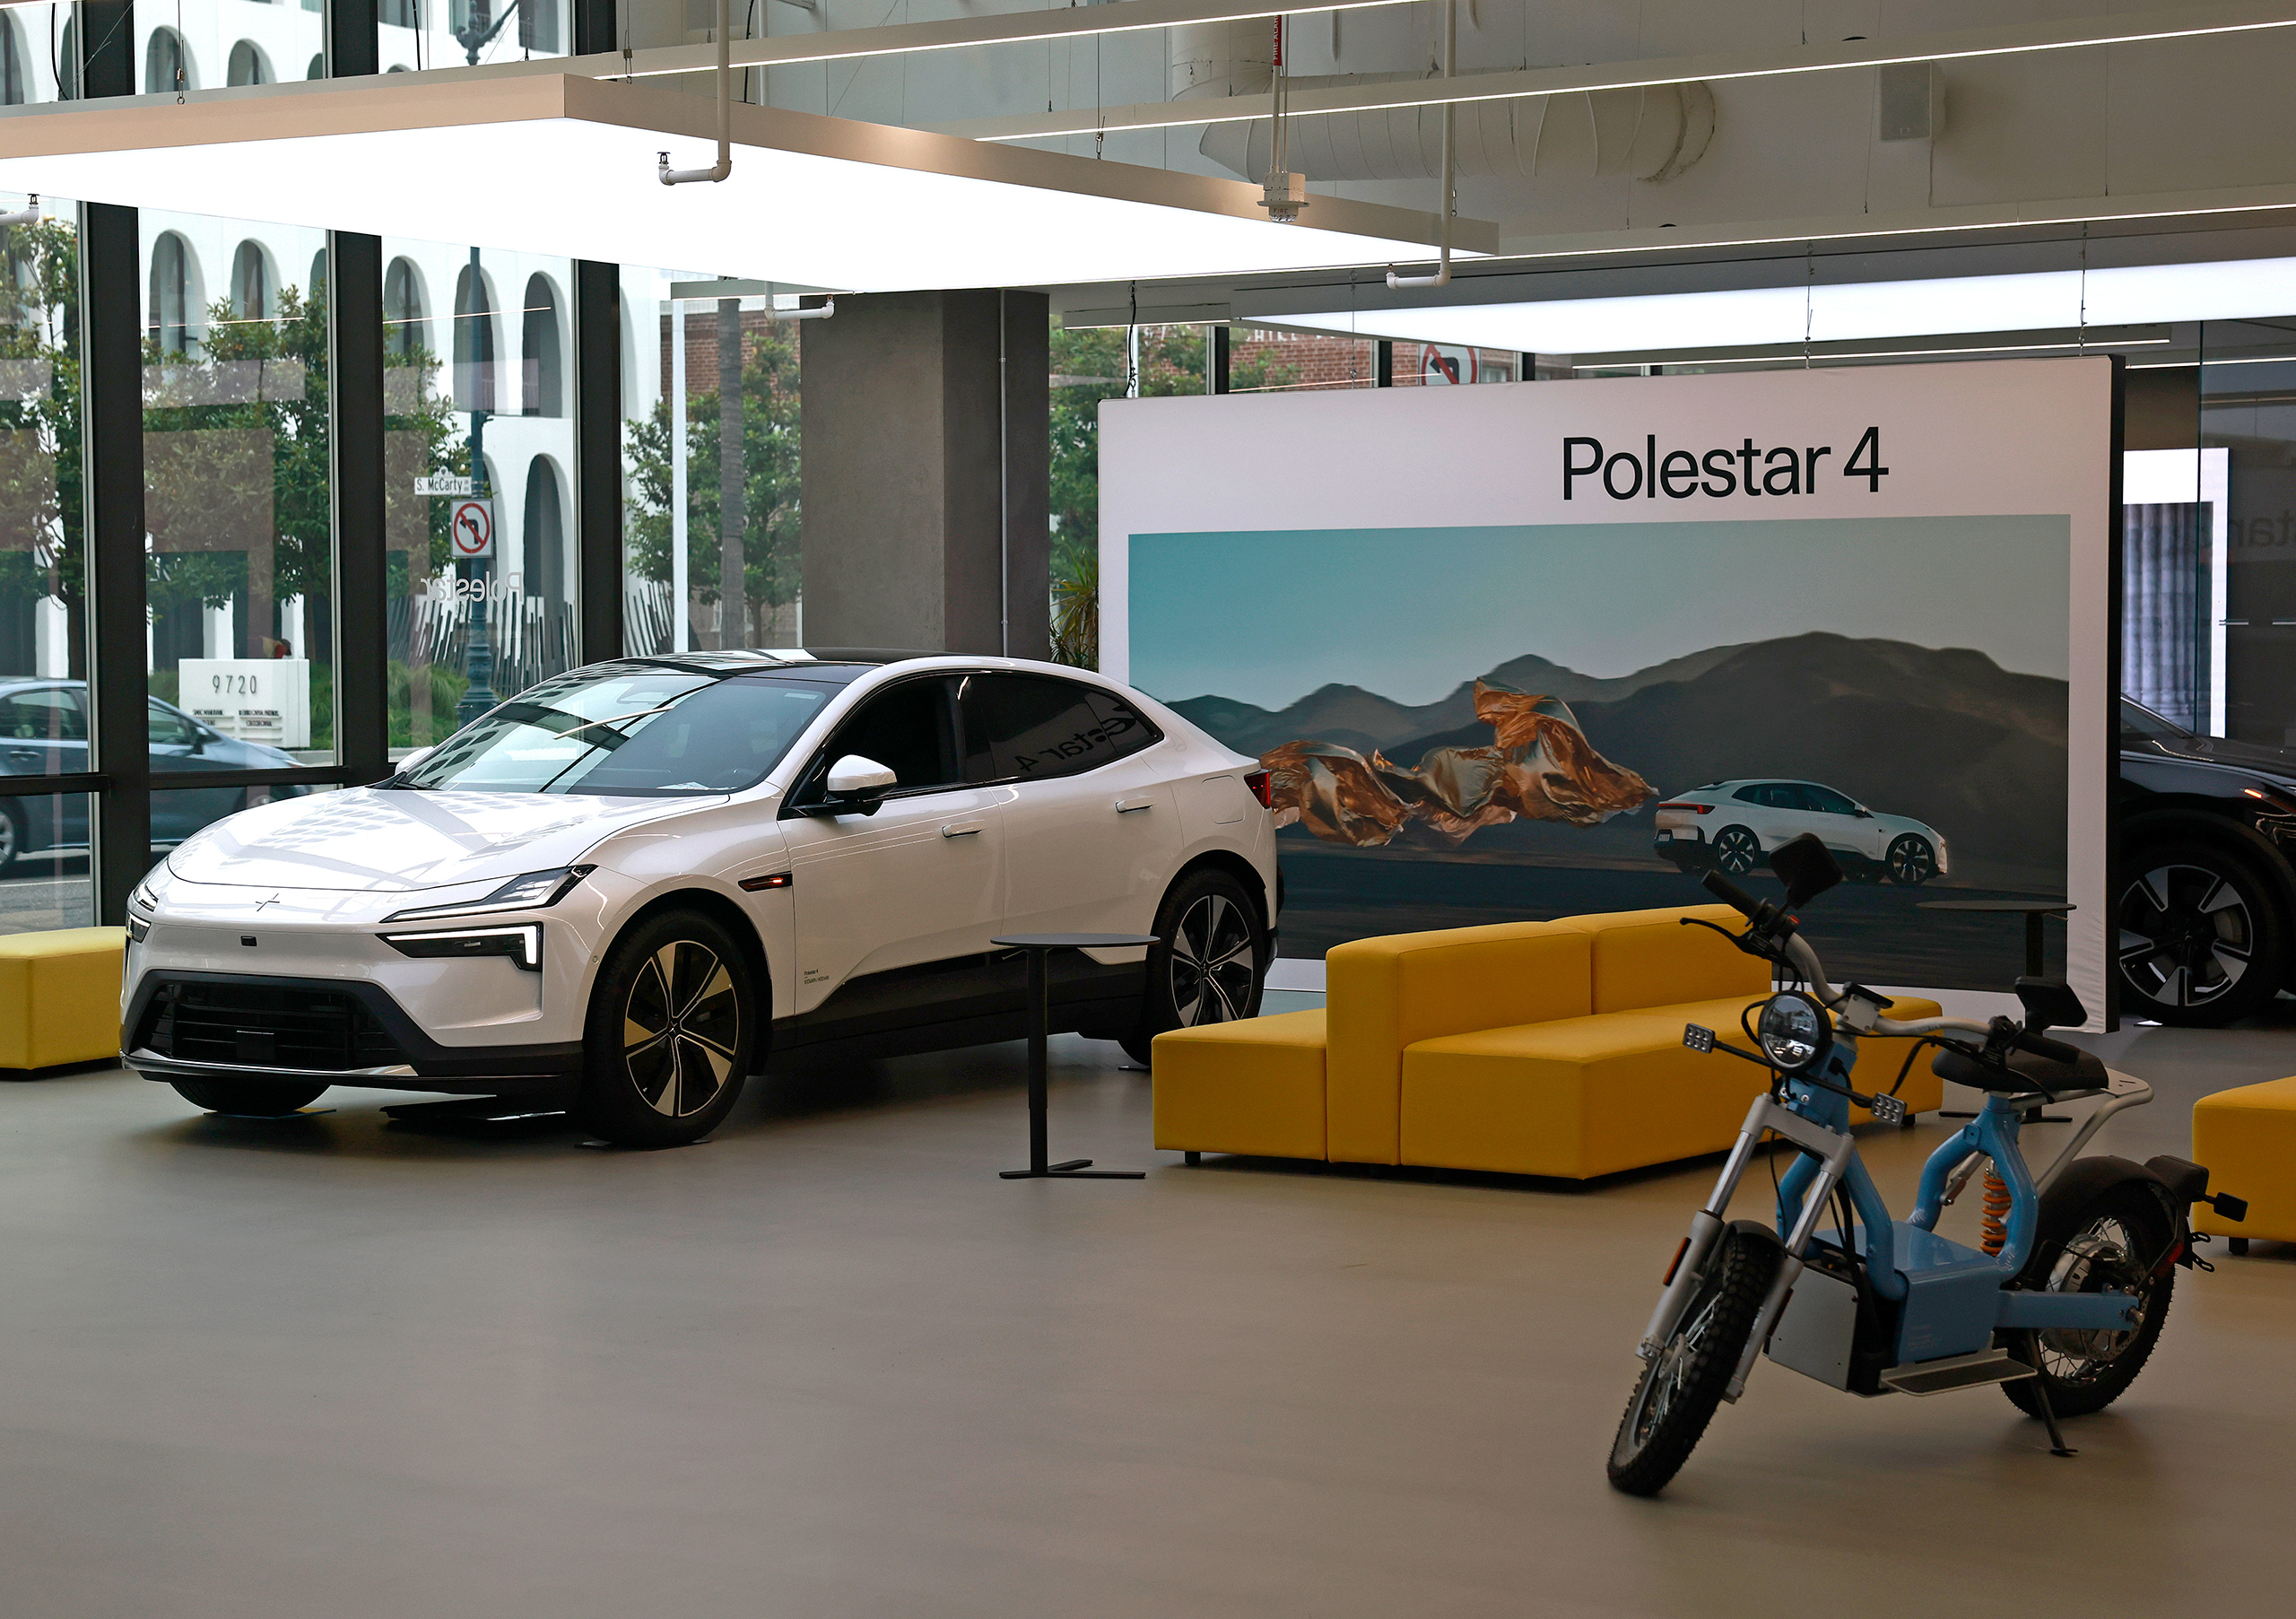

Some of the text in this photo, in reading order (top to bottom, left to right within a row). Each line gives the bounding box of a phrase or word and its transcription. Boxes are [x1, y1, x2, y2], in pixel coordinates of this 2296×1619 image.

[1563, 426, 1890, 500] Polestar 4
[416, 477, 463, 493] S. McCarty
[213, 675, 257, 694] 9720
